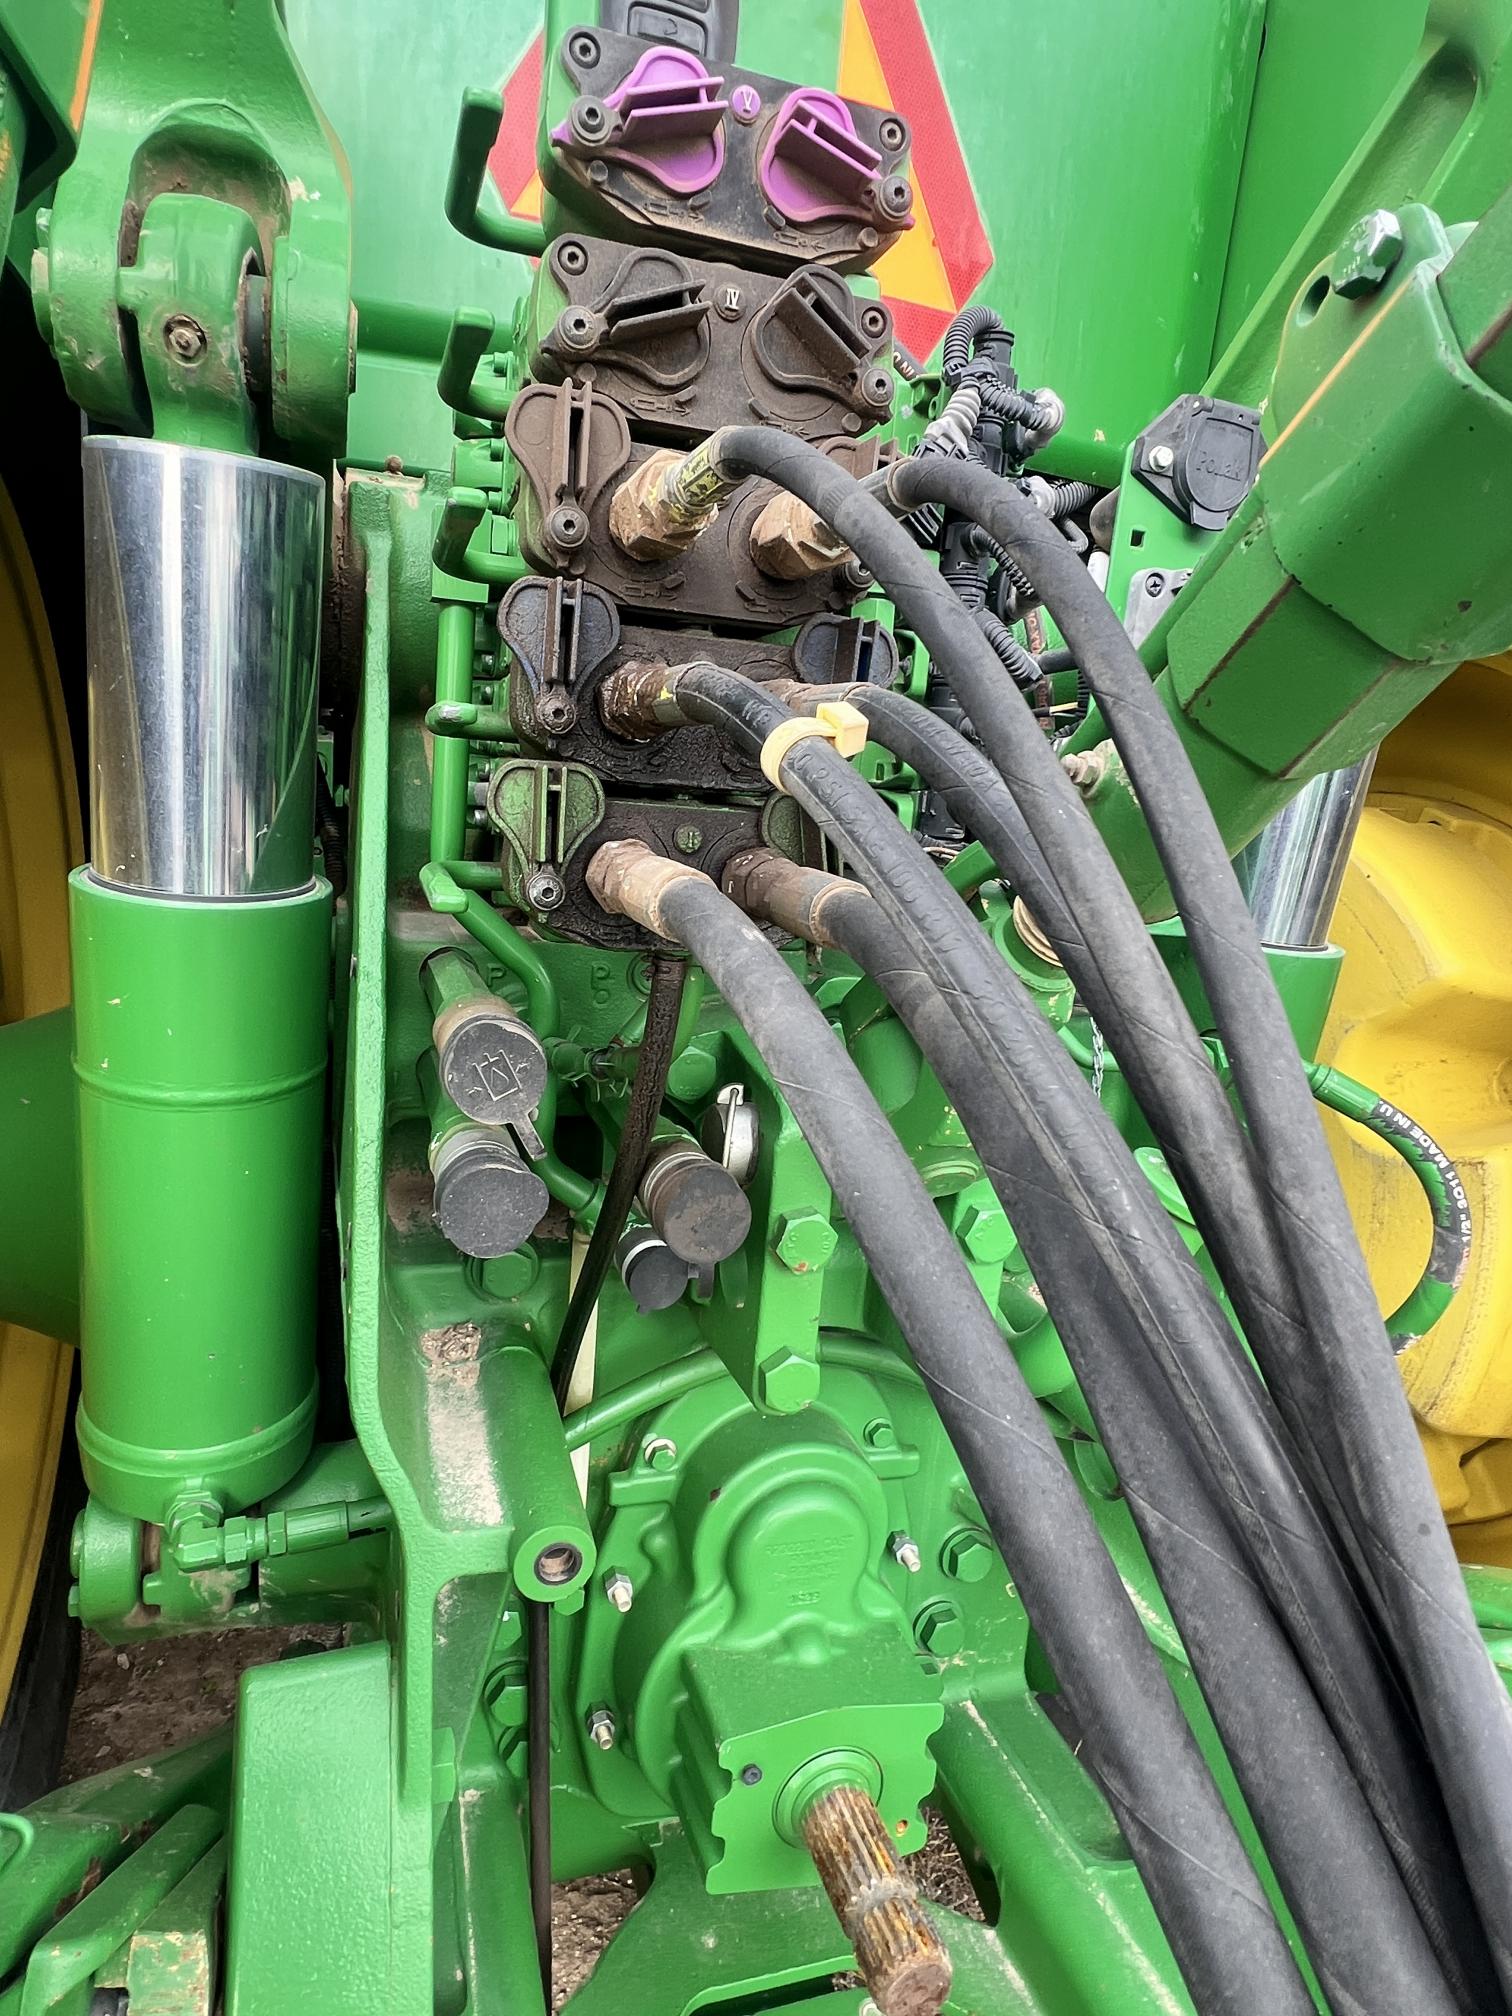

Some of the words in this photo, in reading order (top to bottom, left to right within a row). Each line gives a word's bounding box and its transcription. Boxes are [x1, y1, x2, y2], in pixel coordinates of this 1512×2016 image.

[741, 92, 754, 112] V
[724, 287, 740, 310] IV
[1393, 1112, 1412, 1129] IN
[1409, 1126, 1450, 1169] MADE
